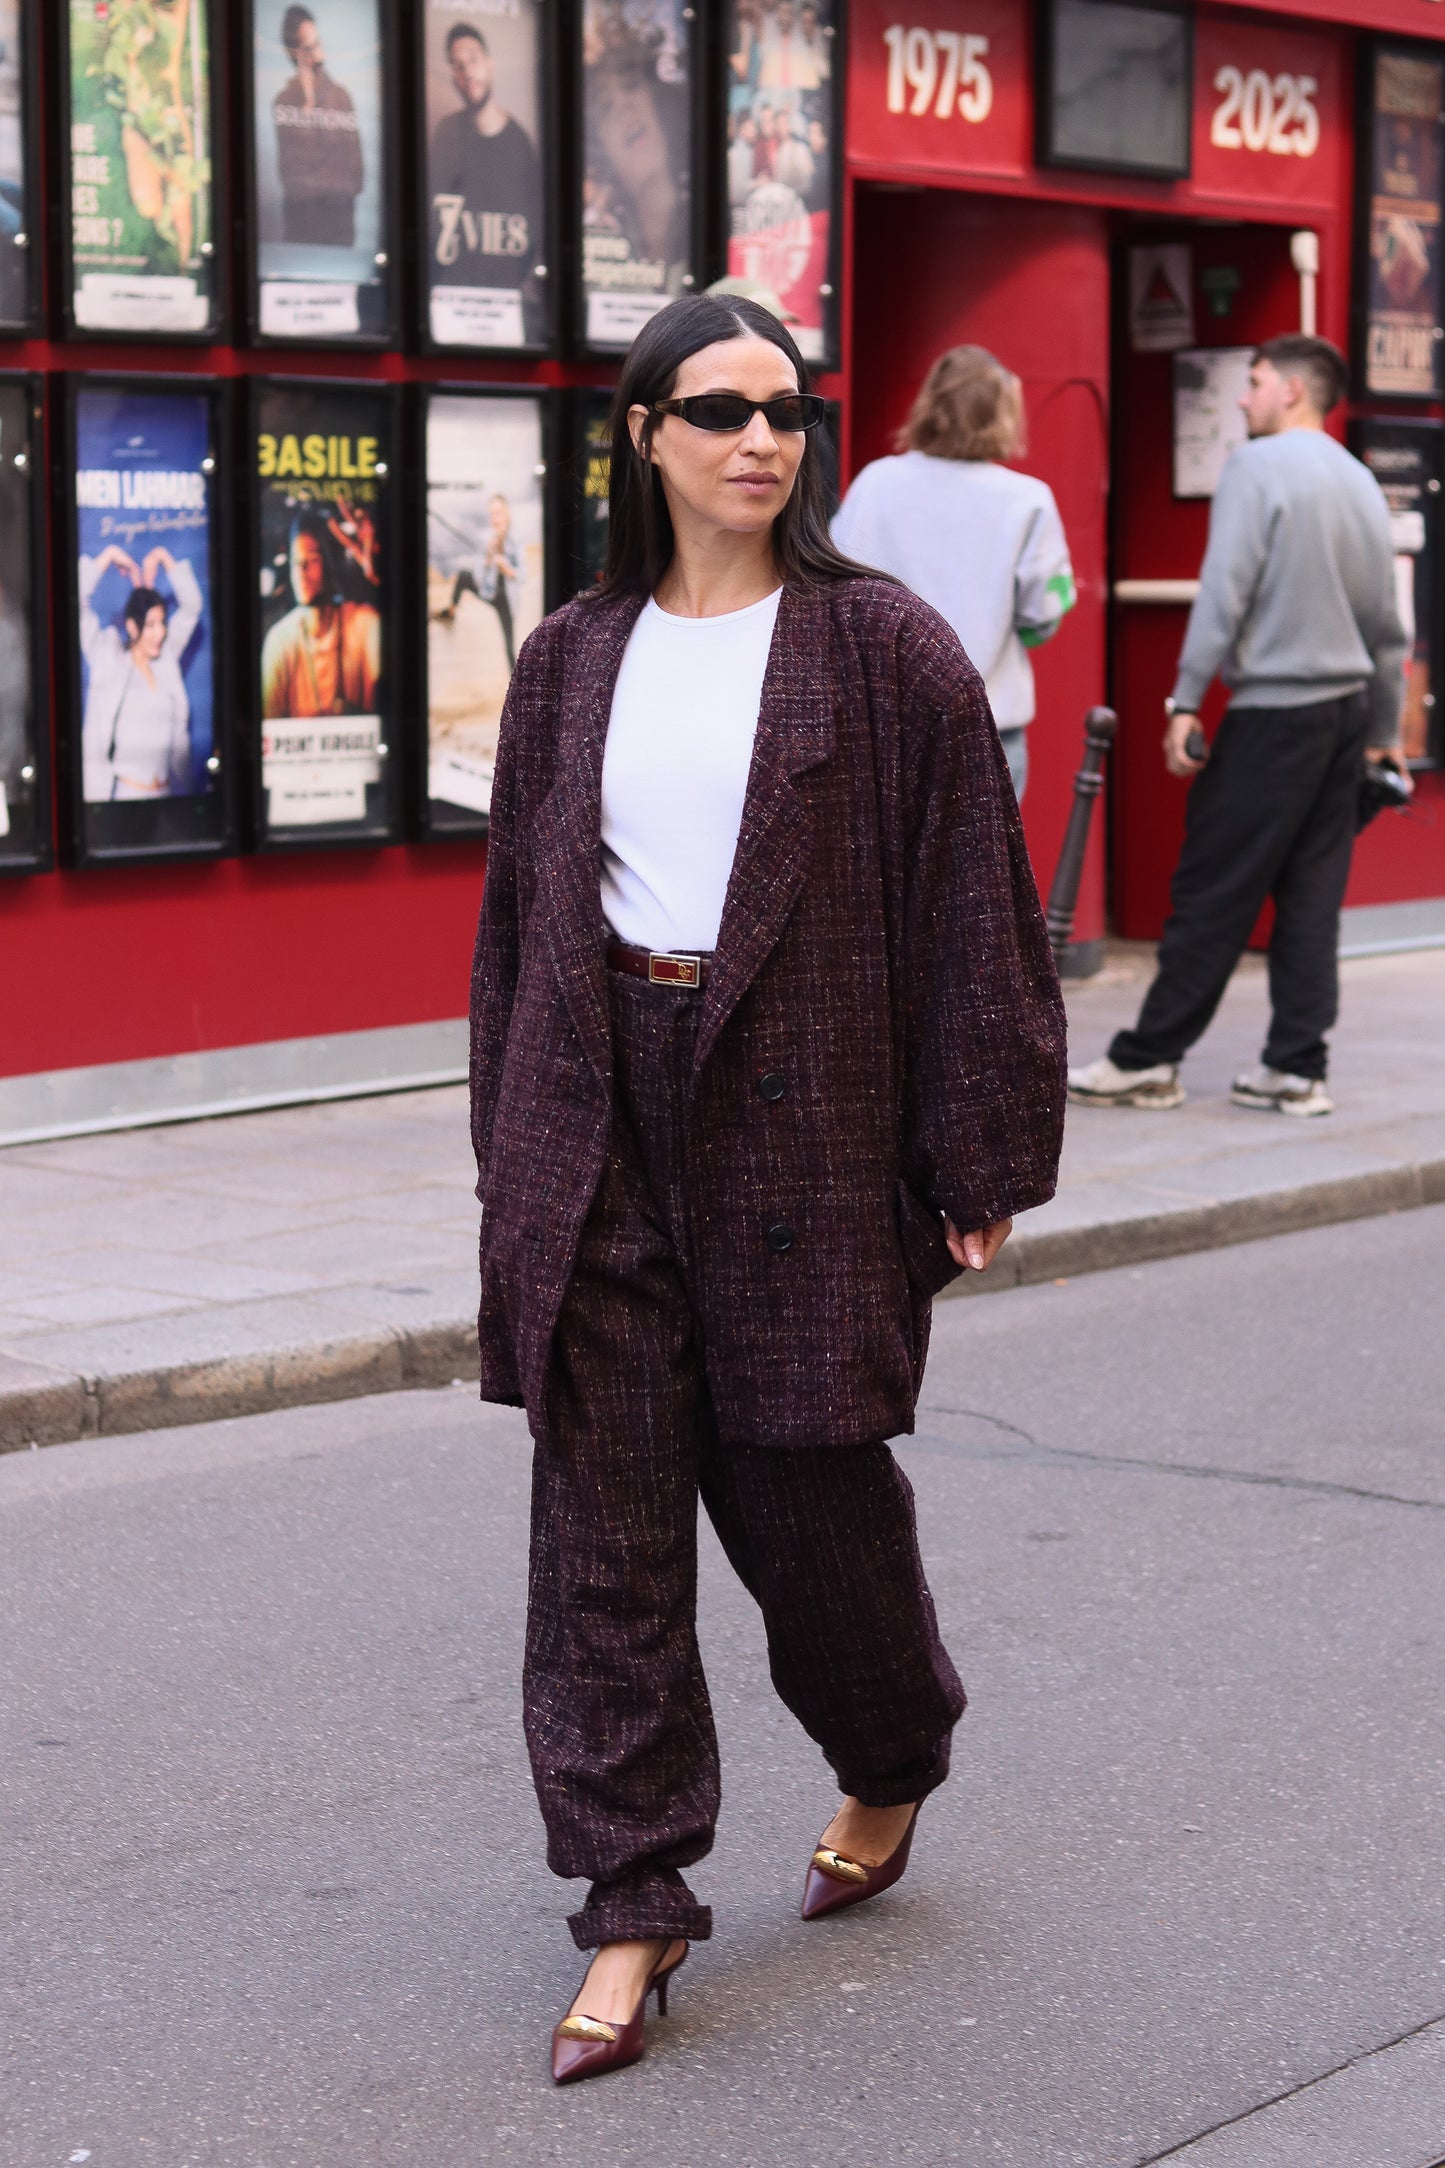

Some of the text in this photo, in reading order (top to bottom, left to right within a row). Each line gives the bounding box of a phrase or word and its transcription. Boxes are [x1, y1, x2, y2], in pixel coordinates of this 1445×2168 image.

[883, 24, 993, 123] 1975
[1210, 65, 1320, 158] 2025
[461, 210, 529, 257] VIES
[258, 434, 378, 478] BASILE
